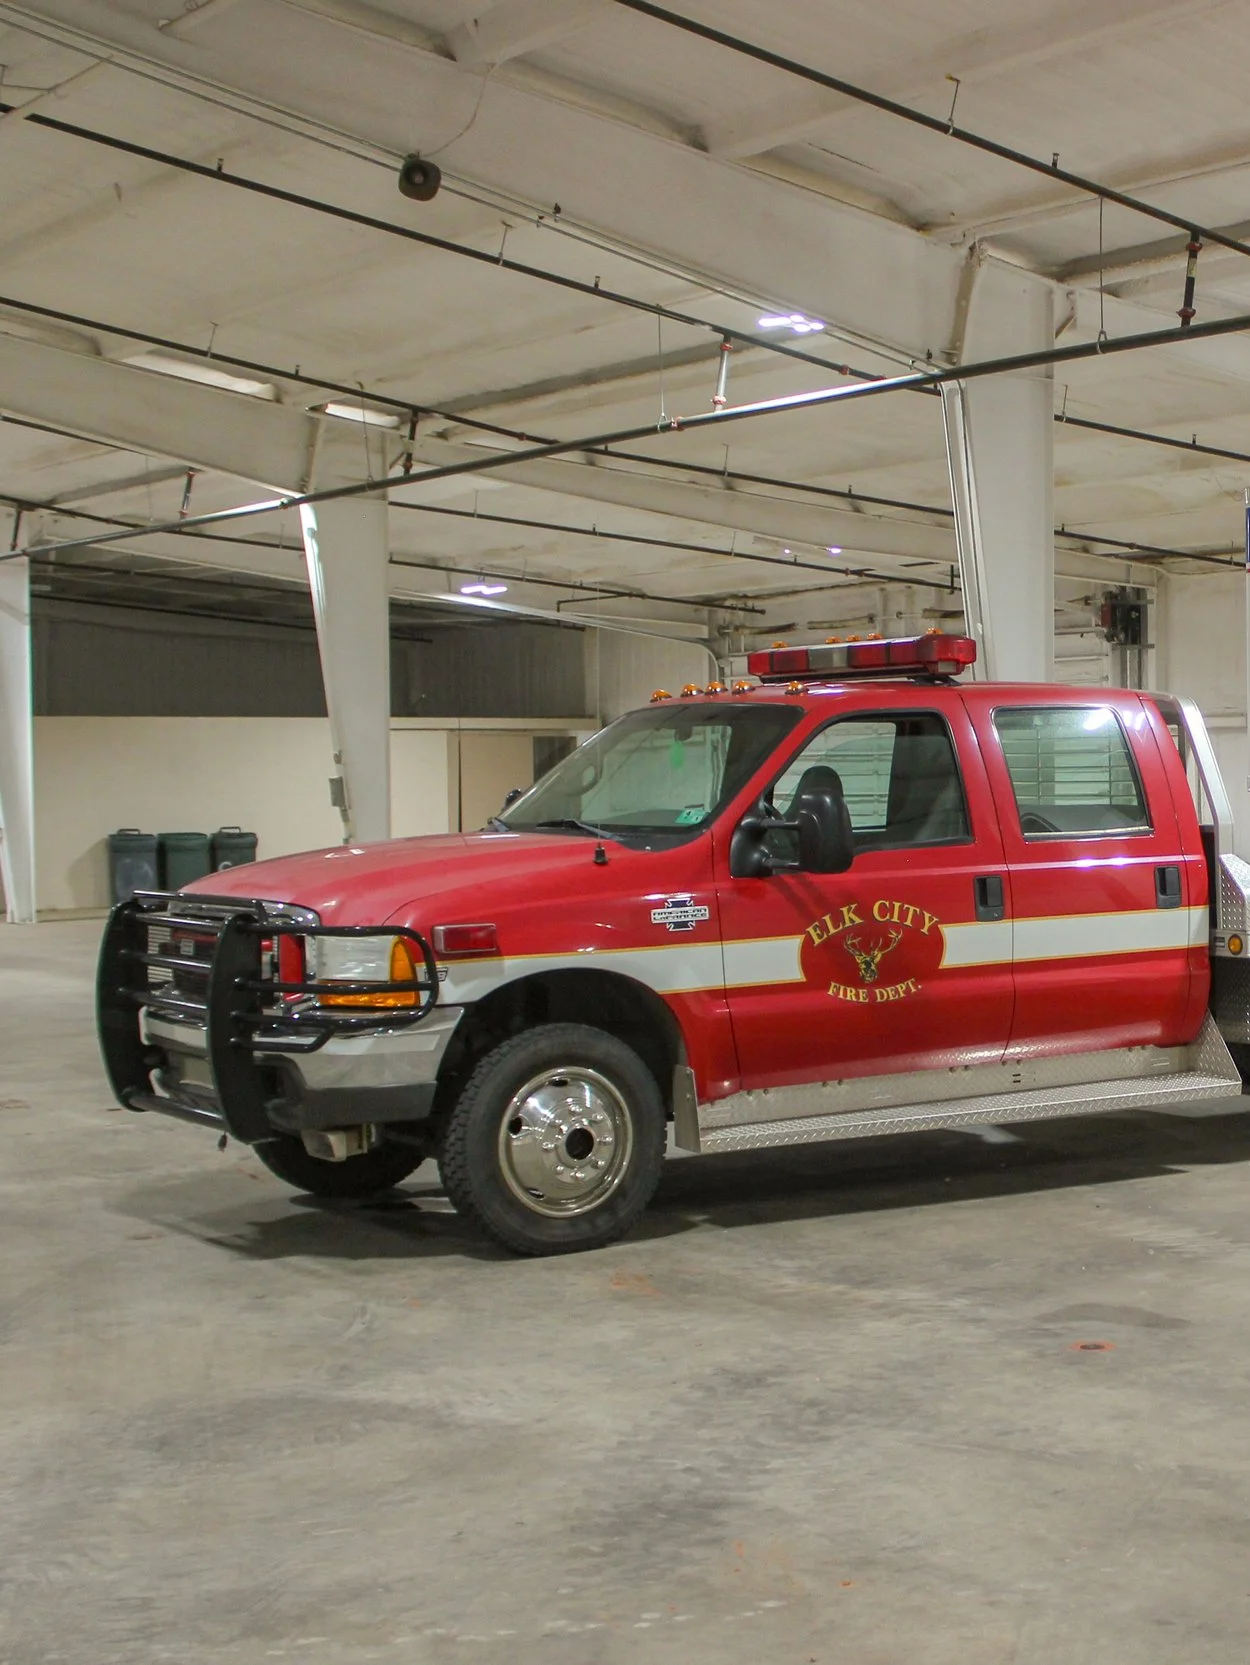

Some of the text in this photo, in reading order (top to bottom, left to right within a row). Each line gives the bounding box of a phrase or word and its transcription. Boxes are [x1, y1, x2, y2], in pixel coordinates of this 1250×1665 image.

[805, 899, 940, 947] ELK CITY
[827, 981, 869, 1003] FIRE
